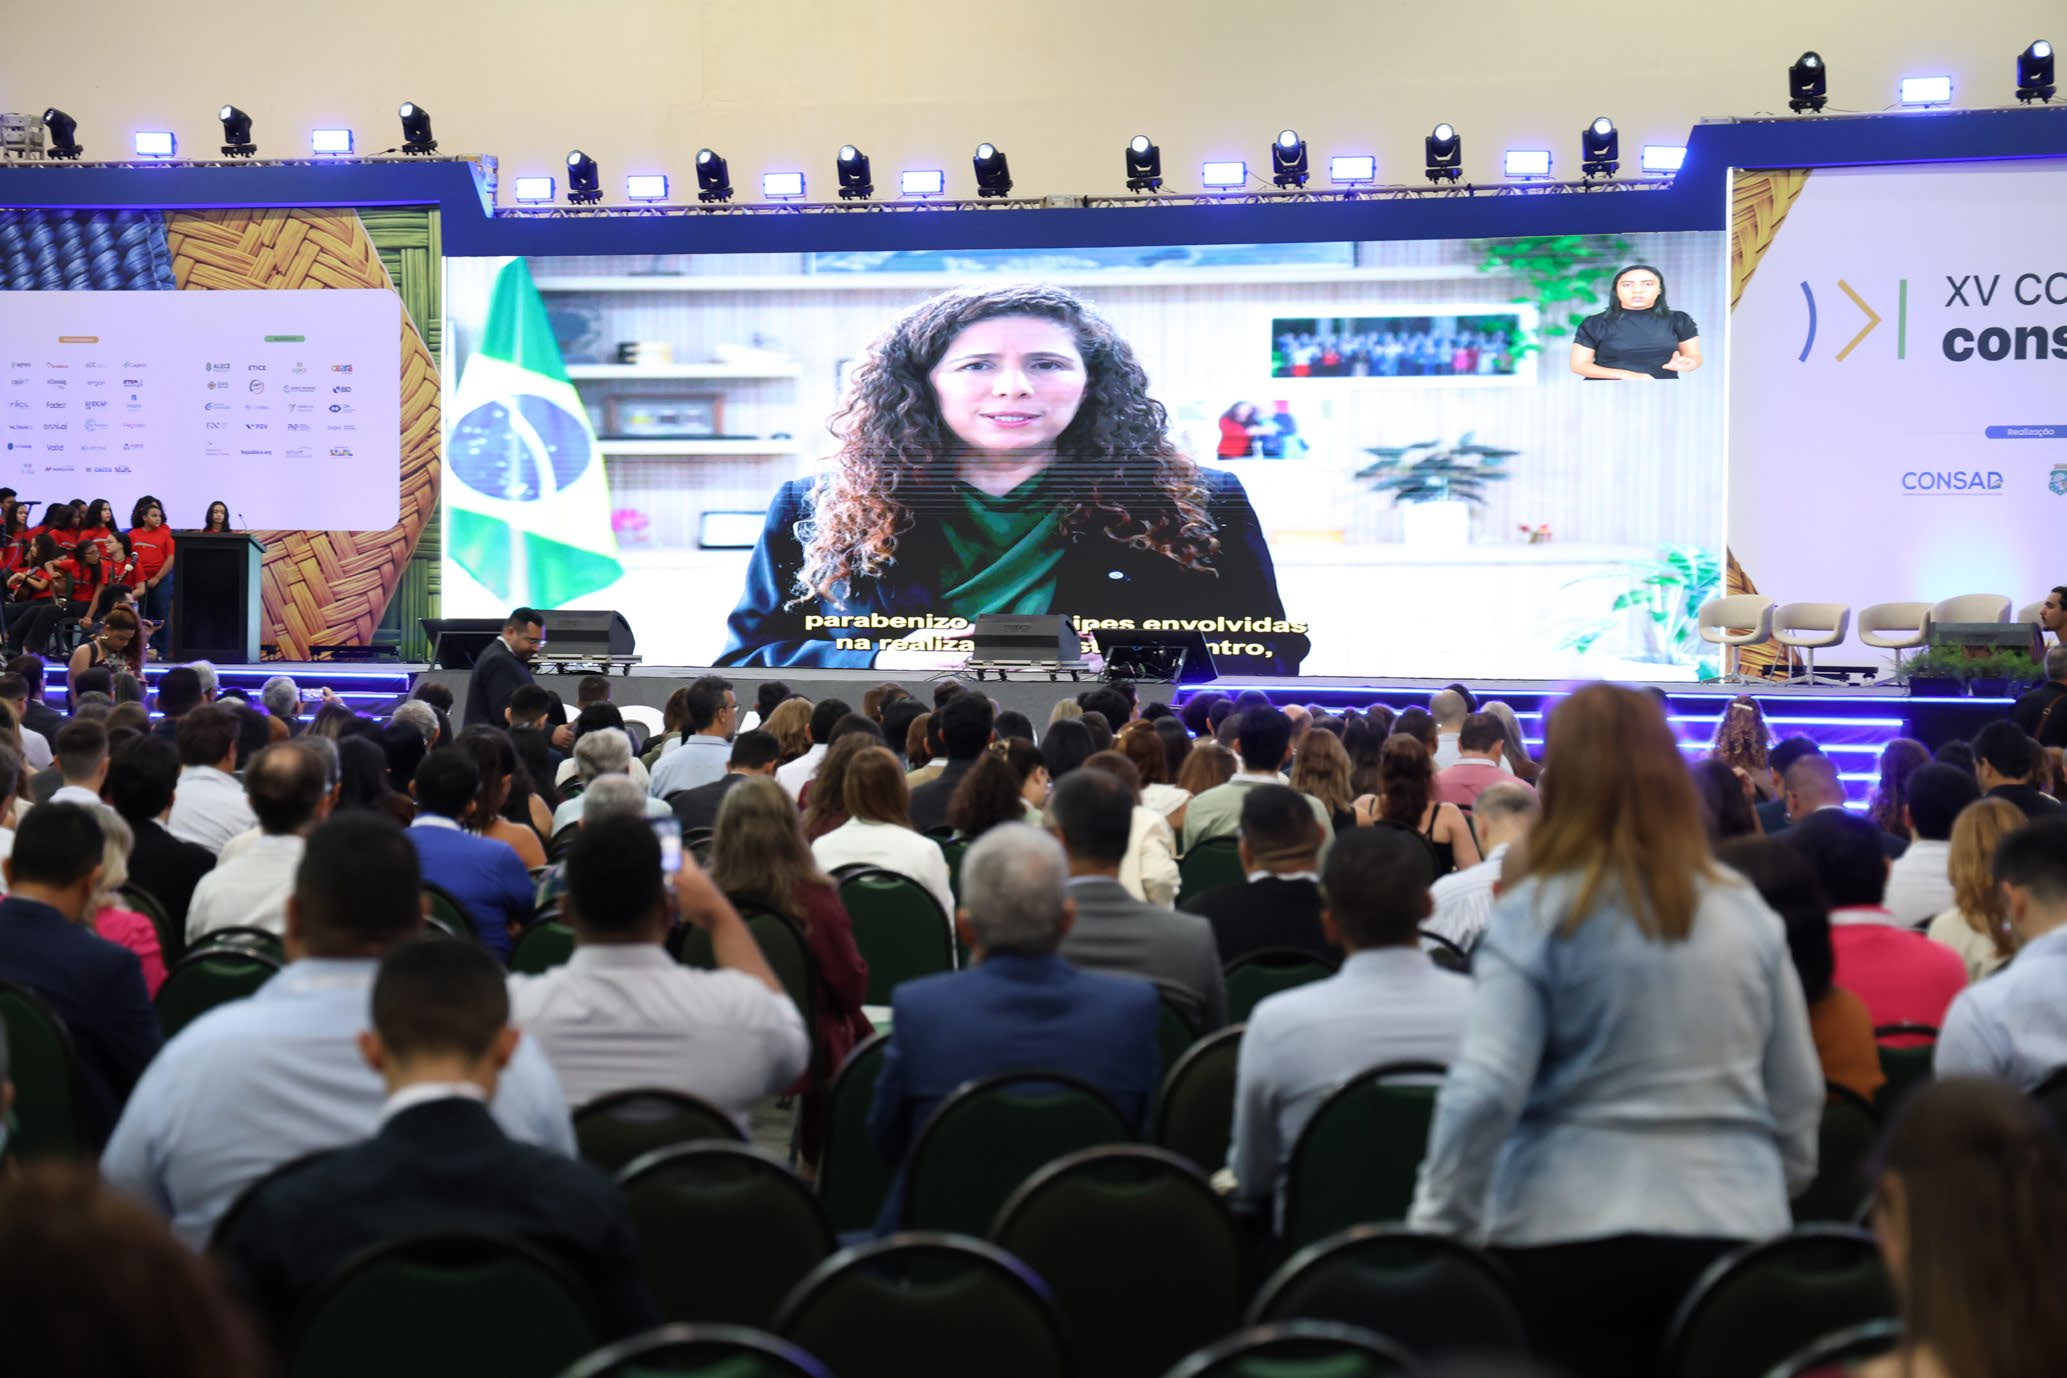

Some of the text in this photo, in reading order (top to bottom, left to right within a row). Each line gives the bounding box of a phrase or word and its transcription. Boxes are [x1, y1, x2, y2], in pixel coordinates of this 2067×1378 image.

[1945, 274, 2000, 307] XV
[2007, 428, 2055, 437] Realização
[1902, 471, 2004, 490] CONSAD
[805, 613, 1308, 634] parabenizo ipes envolvidas
[836, 636, 1273, 658] na realiza ntro,
